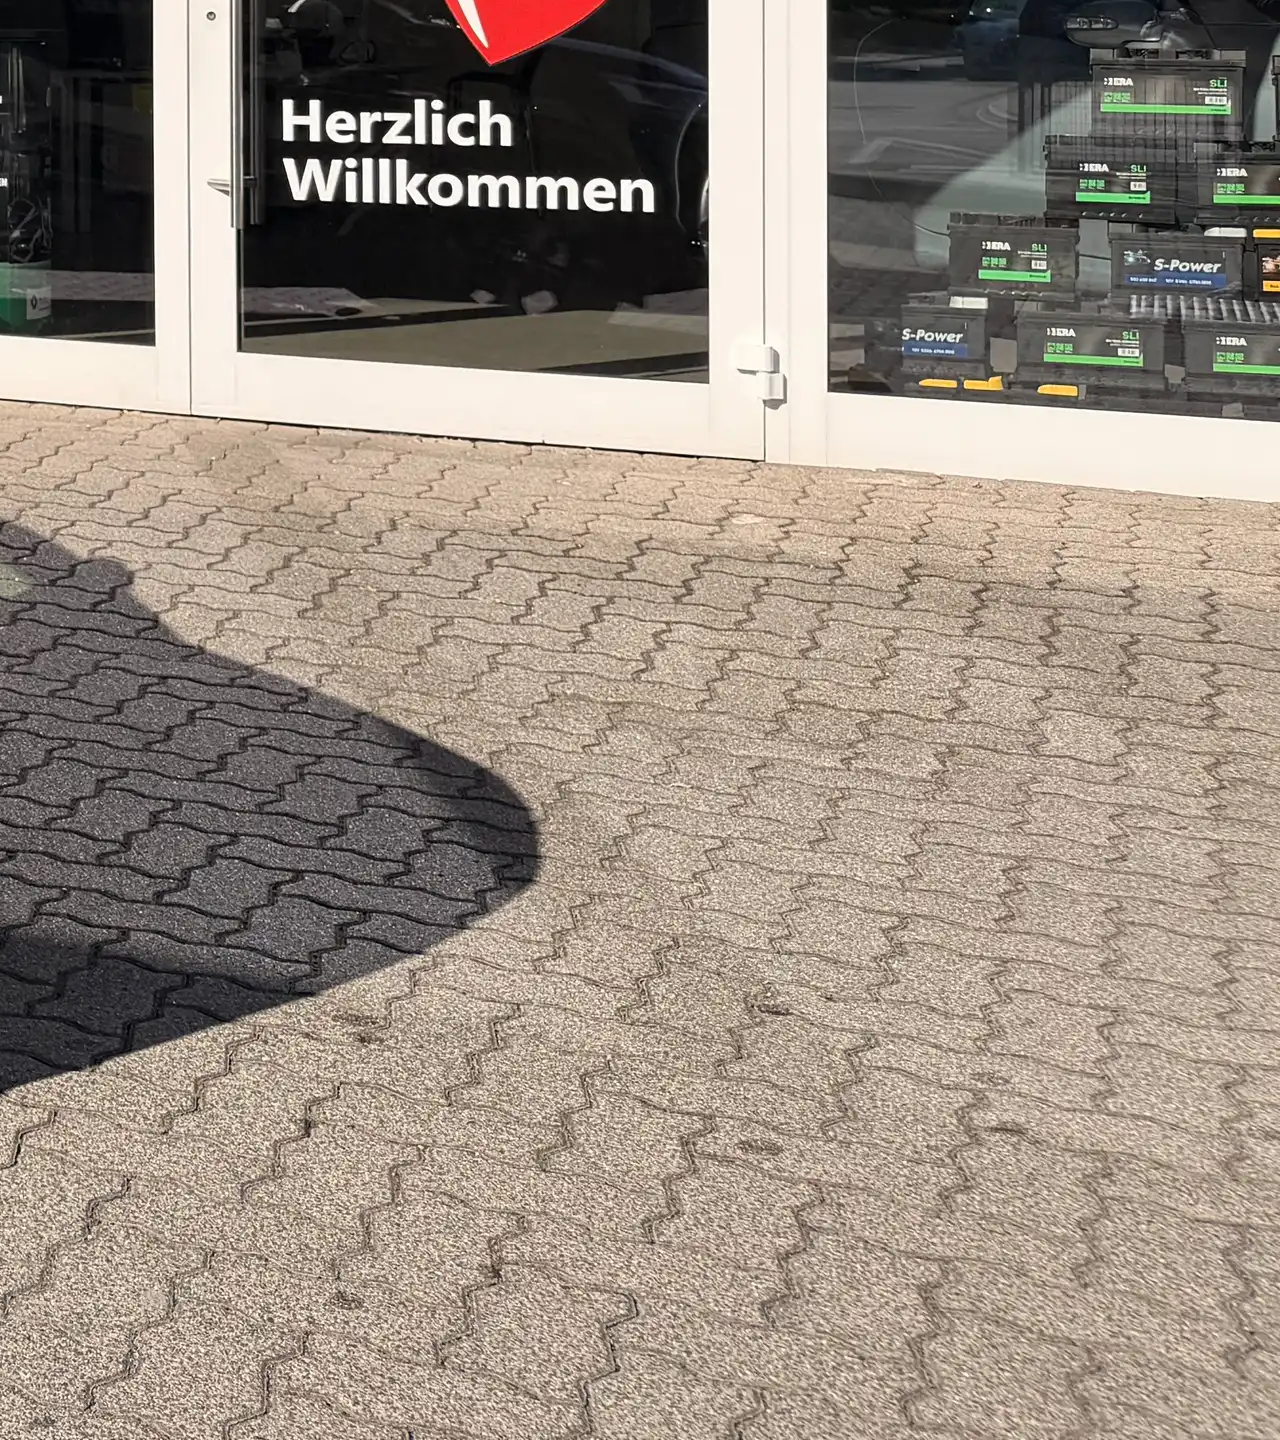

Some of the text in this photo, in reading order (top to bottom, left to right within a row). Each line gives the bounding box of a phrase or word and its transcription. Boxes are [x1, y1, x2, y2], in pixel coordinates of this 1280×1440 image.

[1209, 78, 1228, 88] SLI
[281, 98, 513, 147] Herzlich
[1130, 164, 1147, 173] SLI
[282, 157, 656, 213] Willkommen
[1031, 243, 1047, 252] SLI
[1153, 259, 1222, 273] S-Power
[901, 327, 964, 344] S-Power
[1122, 331, 1140, 340] SLI
